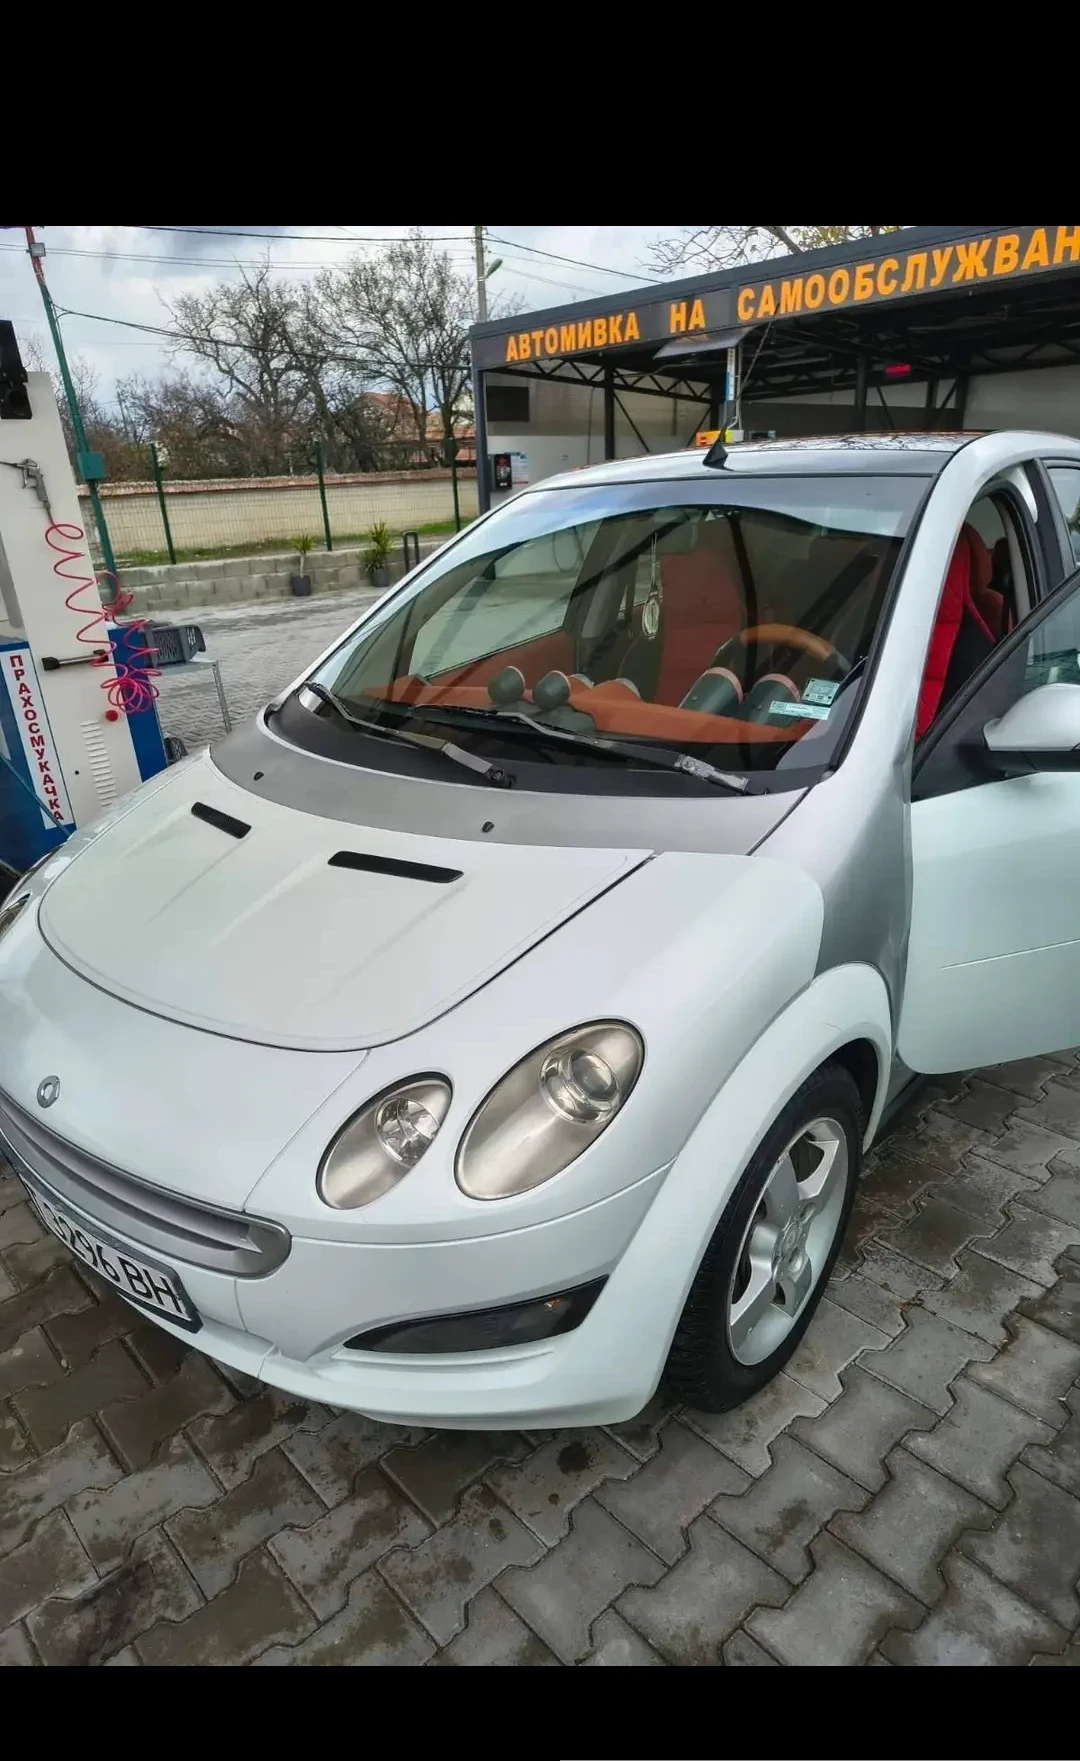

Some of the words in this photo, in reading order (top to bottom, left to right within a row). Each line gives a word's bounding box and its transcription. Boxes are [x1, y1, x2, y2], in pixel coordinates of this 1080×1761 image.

[505, 311, 640, 362] АВТОМИВКА
[669, 298, 706, 334] НА
[736, 226, 1080, 321] САМООБСЛУЖВАН
[9, 655, 64, 821] ПРАХОСМУКАЧКА
